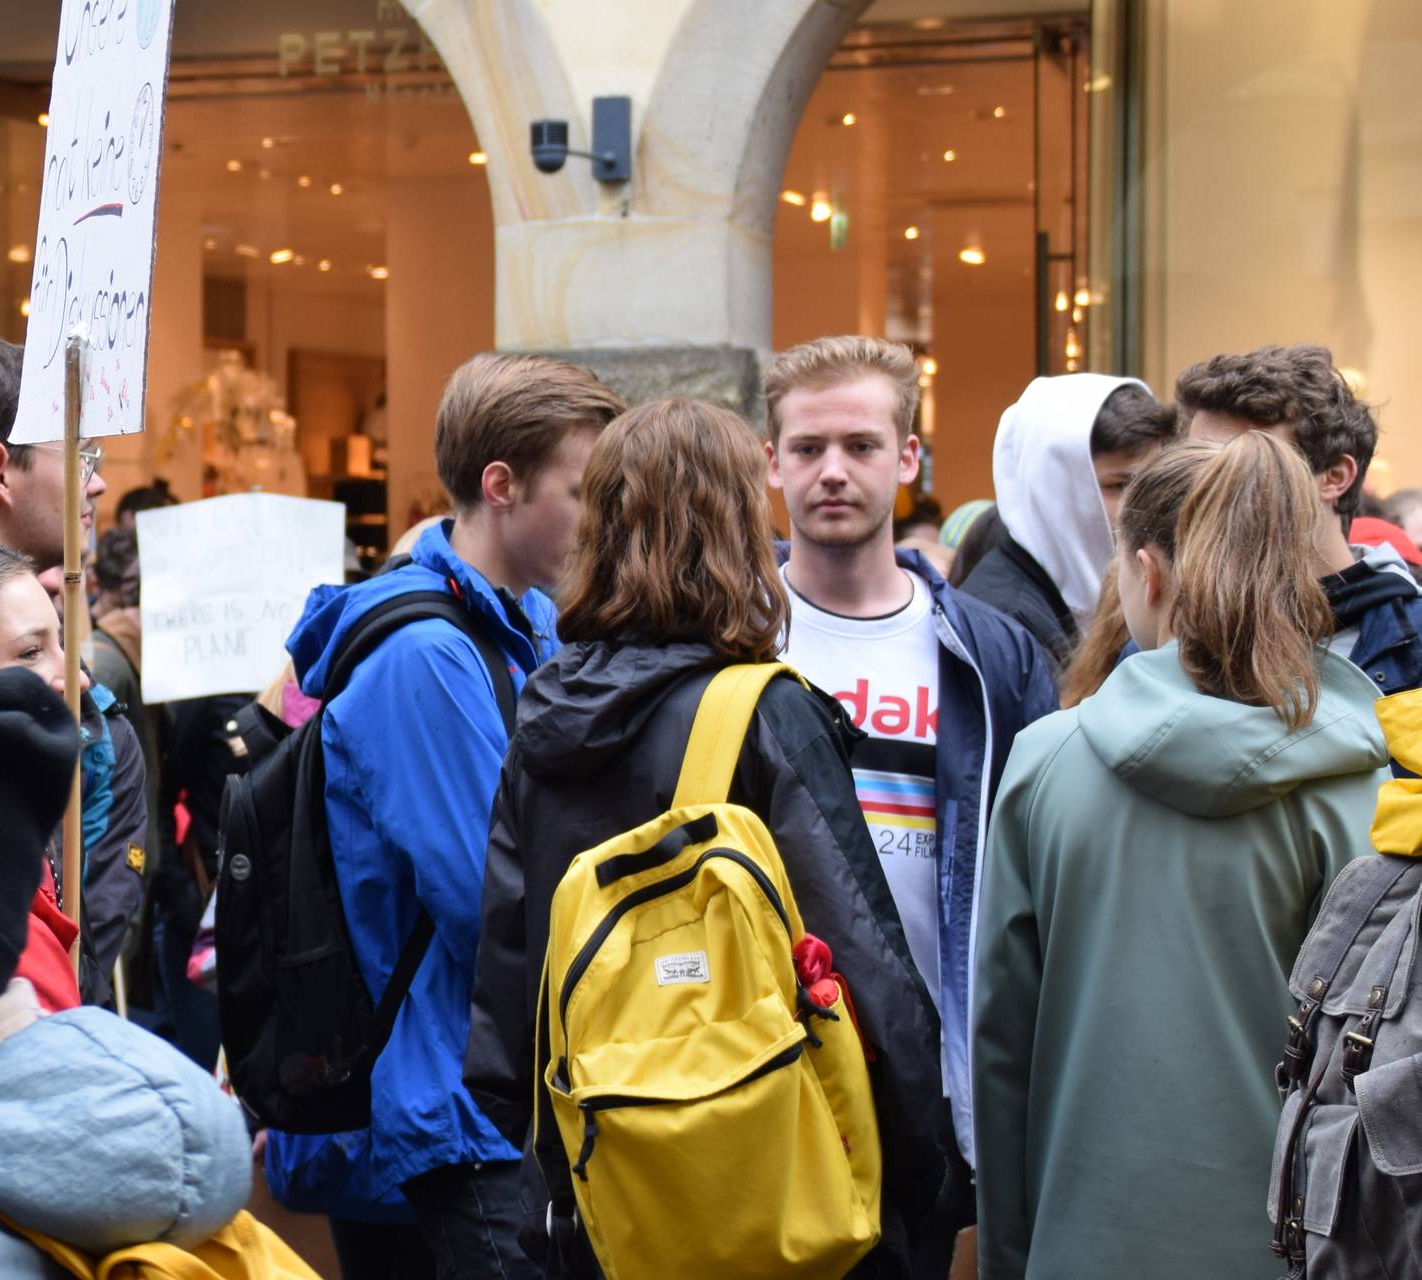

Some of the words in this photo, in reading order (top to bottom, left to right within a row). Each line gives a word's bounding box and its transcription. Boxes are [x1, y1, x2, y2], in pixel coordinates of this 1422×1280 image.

[80, 86, 125, 202] keine
[34, 234, 54, 315] für
[150, 602, 215, 631] THERE
[224, 600, 244, 622] IS
[261, 600, 291, 622] NO
[879, 830, 912, 856] 24
